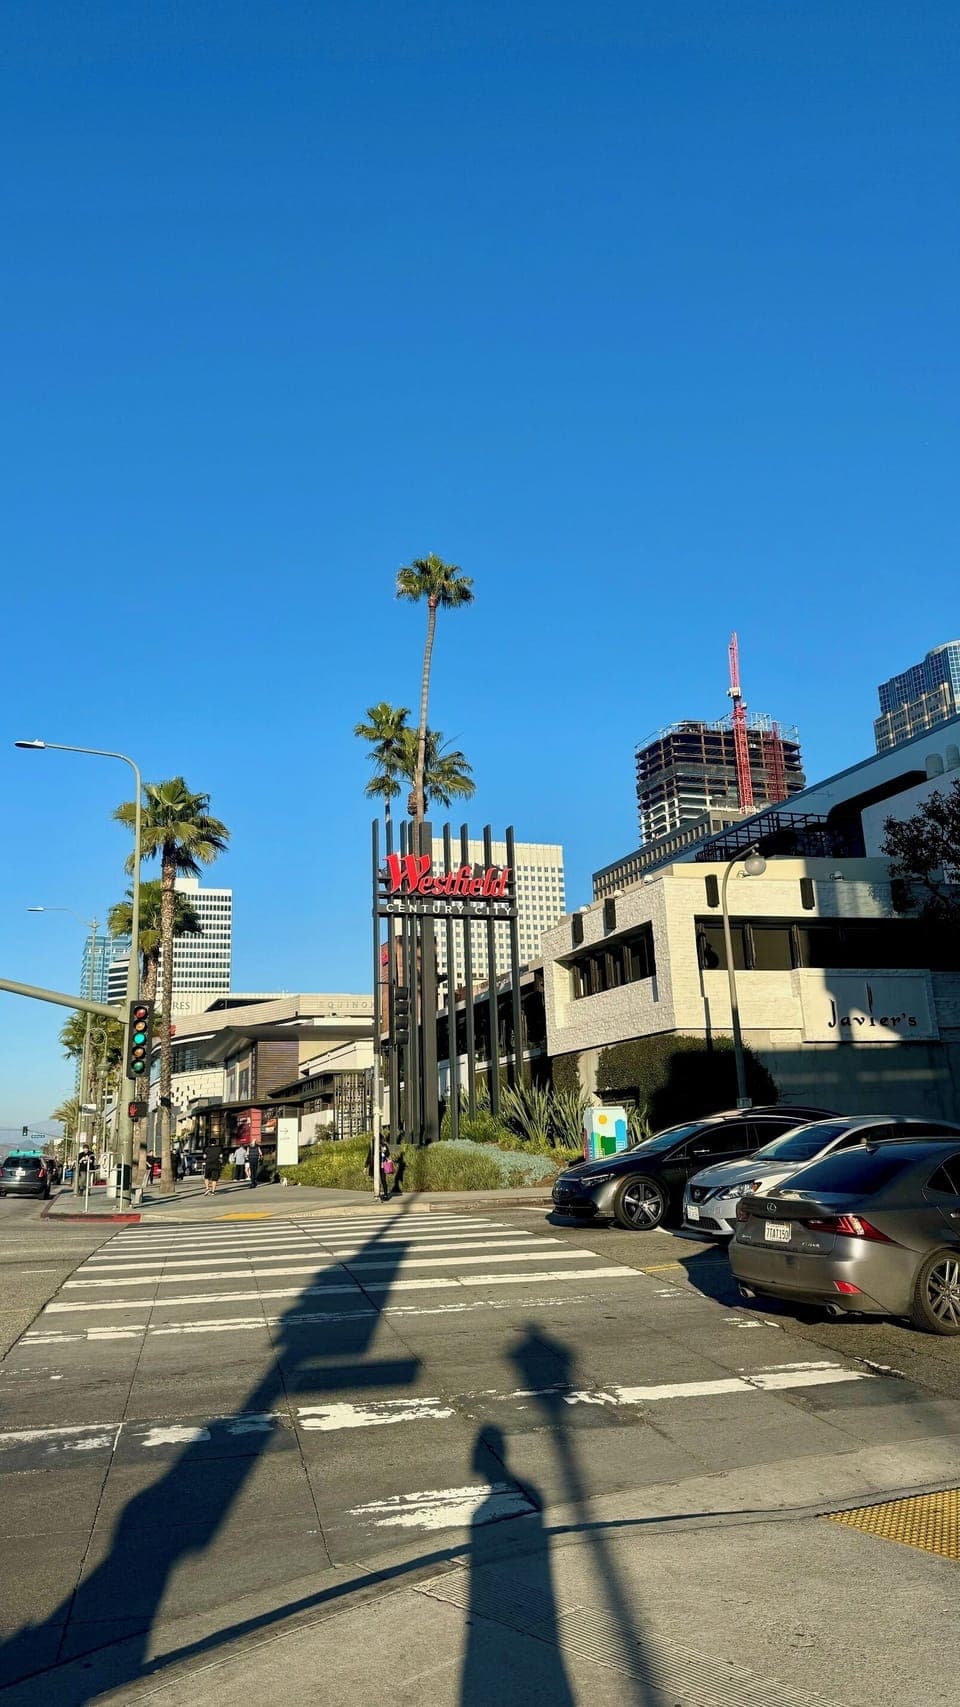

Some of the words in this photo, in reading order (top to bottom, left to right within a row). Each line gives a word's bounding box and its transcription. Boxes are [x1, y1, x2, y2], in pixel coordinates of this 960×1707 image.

[384, 852, 512, 897] Westfield
[386, 903, 465, 914] CENTURY
[475, 905, 512, 916] CITY
[172, 1001, 191, 1010] RES
[828, 982, 917, 1027] Javier's
